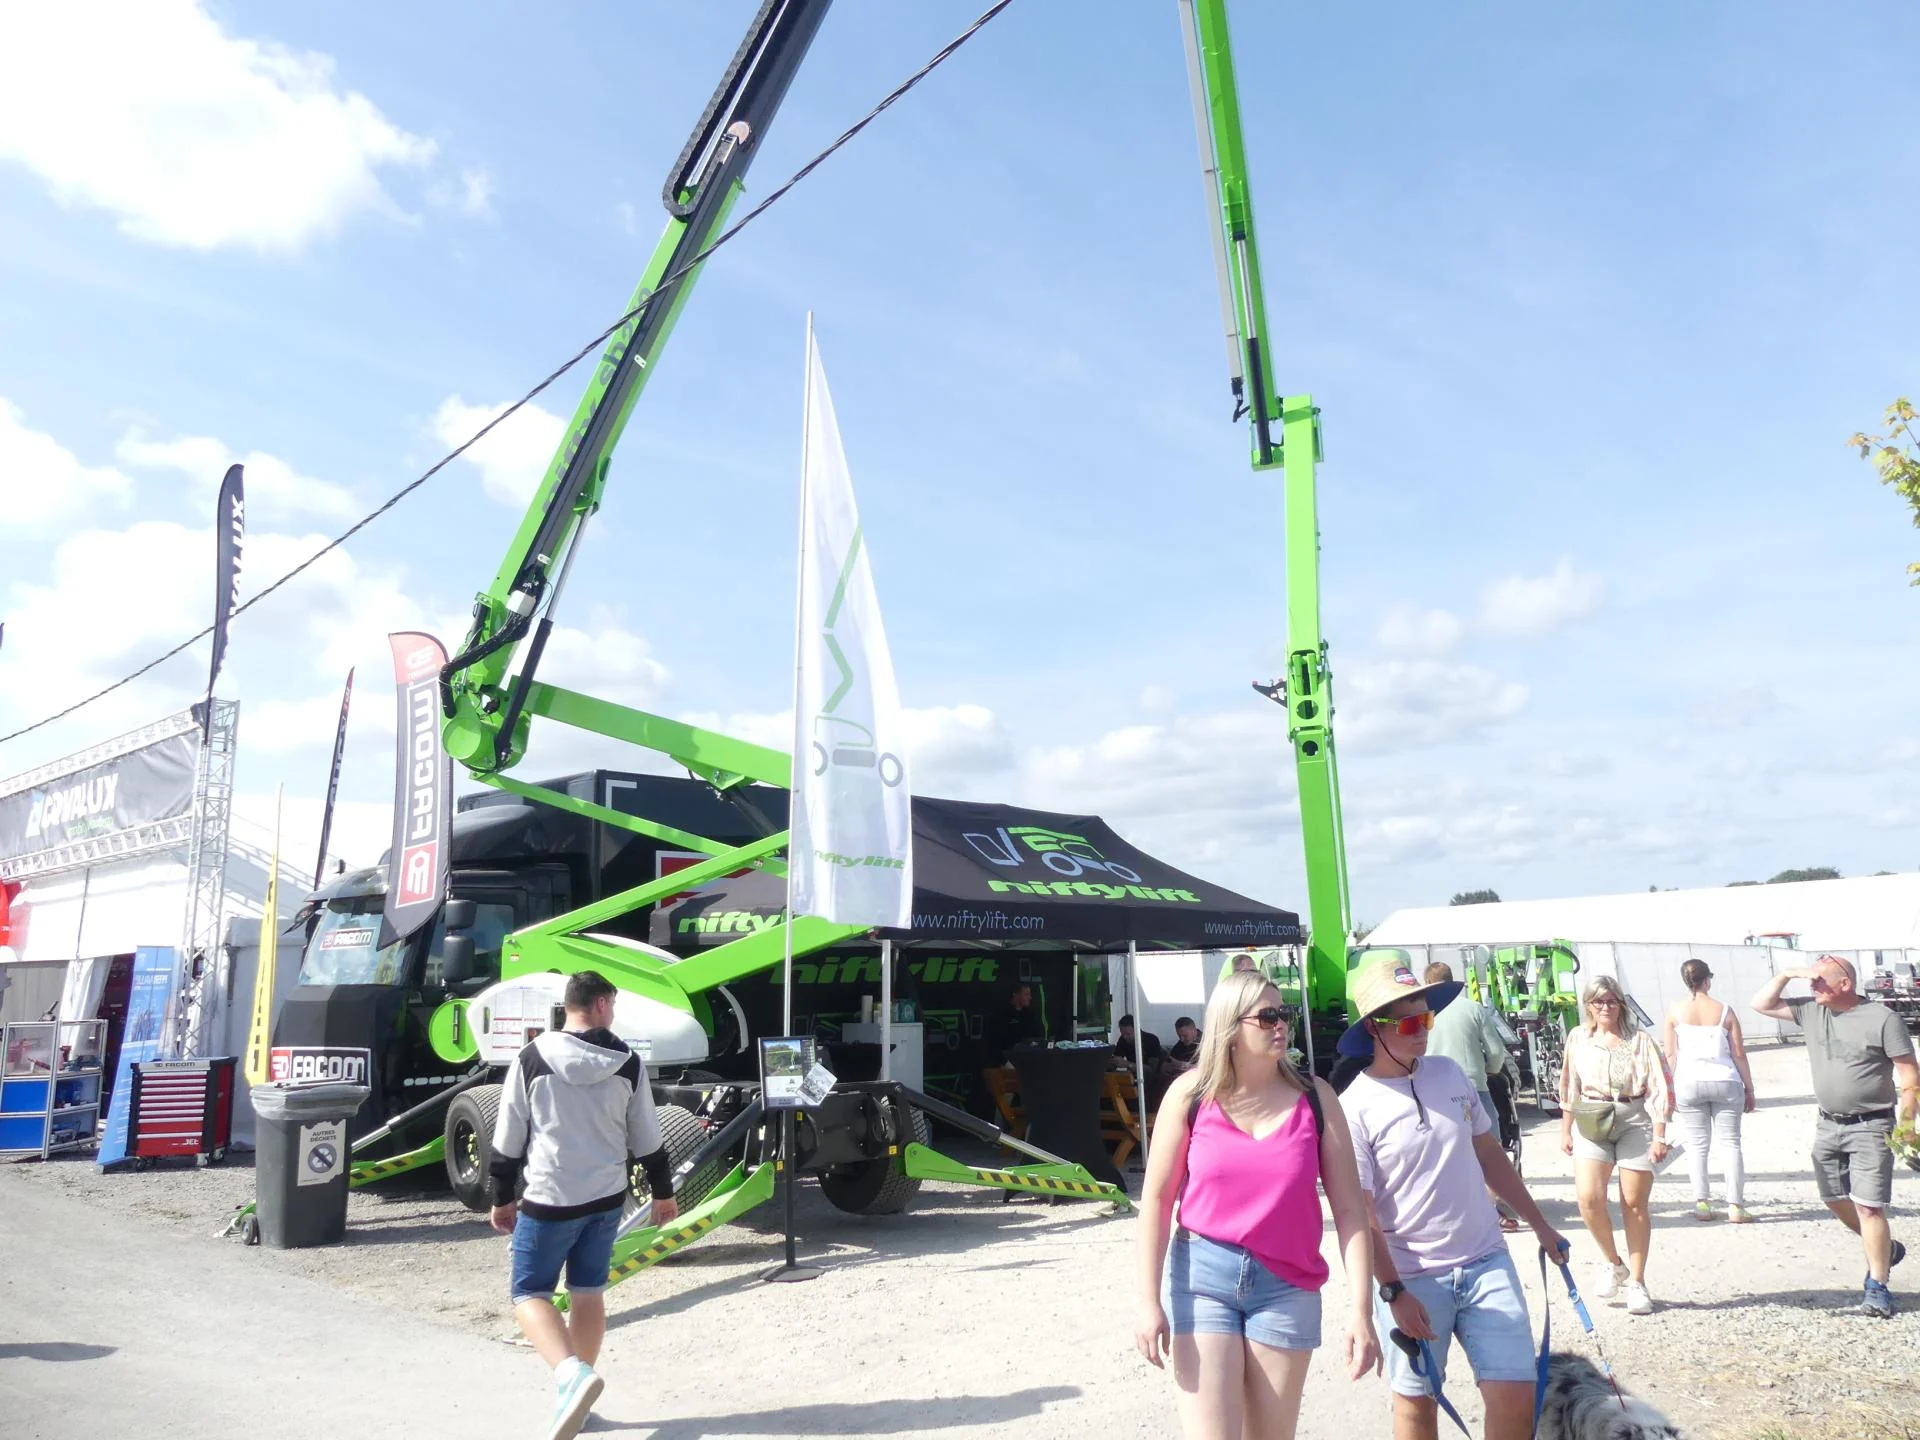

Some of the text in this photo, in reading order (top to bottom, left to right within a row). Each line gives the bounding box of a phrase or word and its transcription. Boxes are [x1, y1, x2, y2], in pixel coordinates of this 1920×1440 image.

[987, 880, 1201, 902] niftylift
[912, 910, 1044, 933] ww.niftylift.com
[1204, 920, 1298, 939] www.niftylift.com
[769, 957, 999, 984] niftlift
[292, 1055, 365, 1081] FACOM
